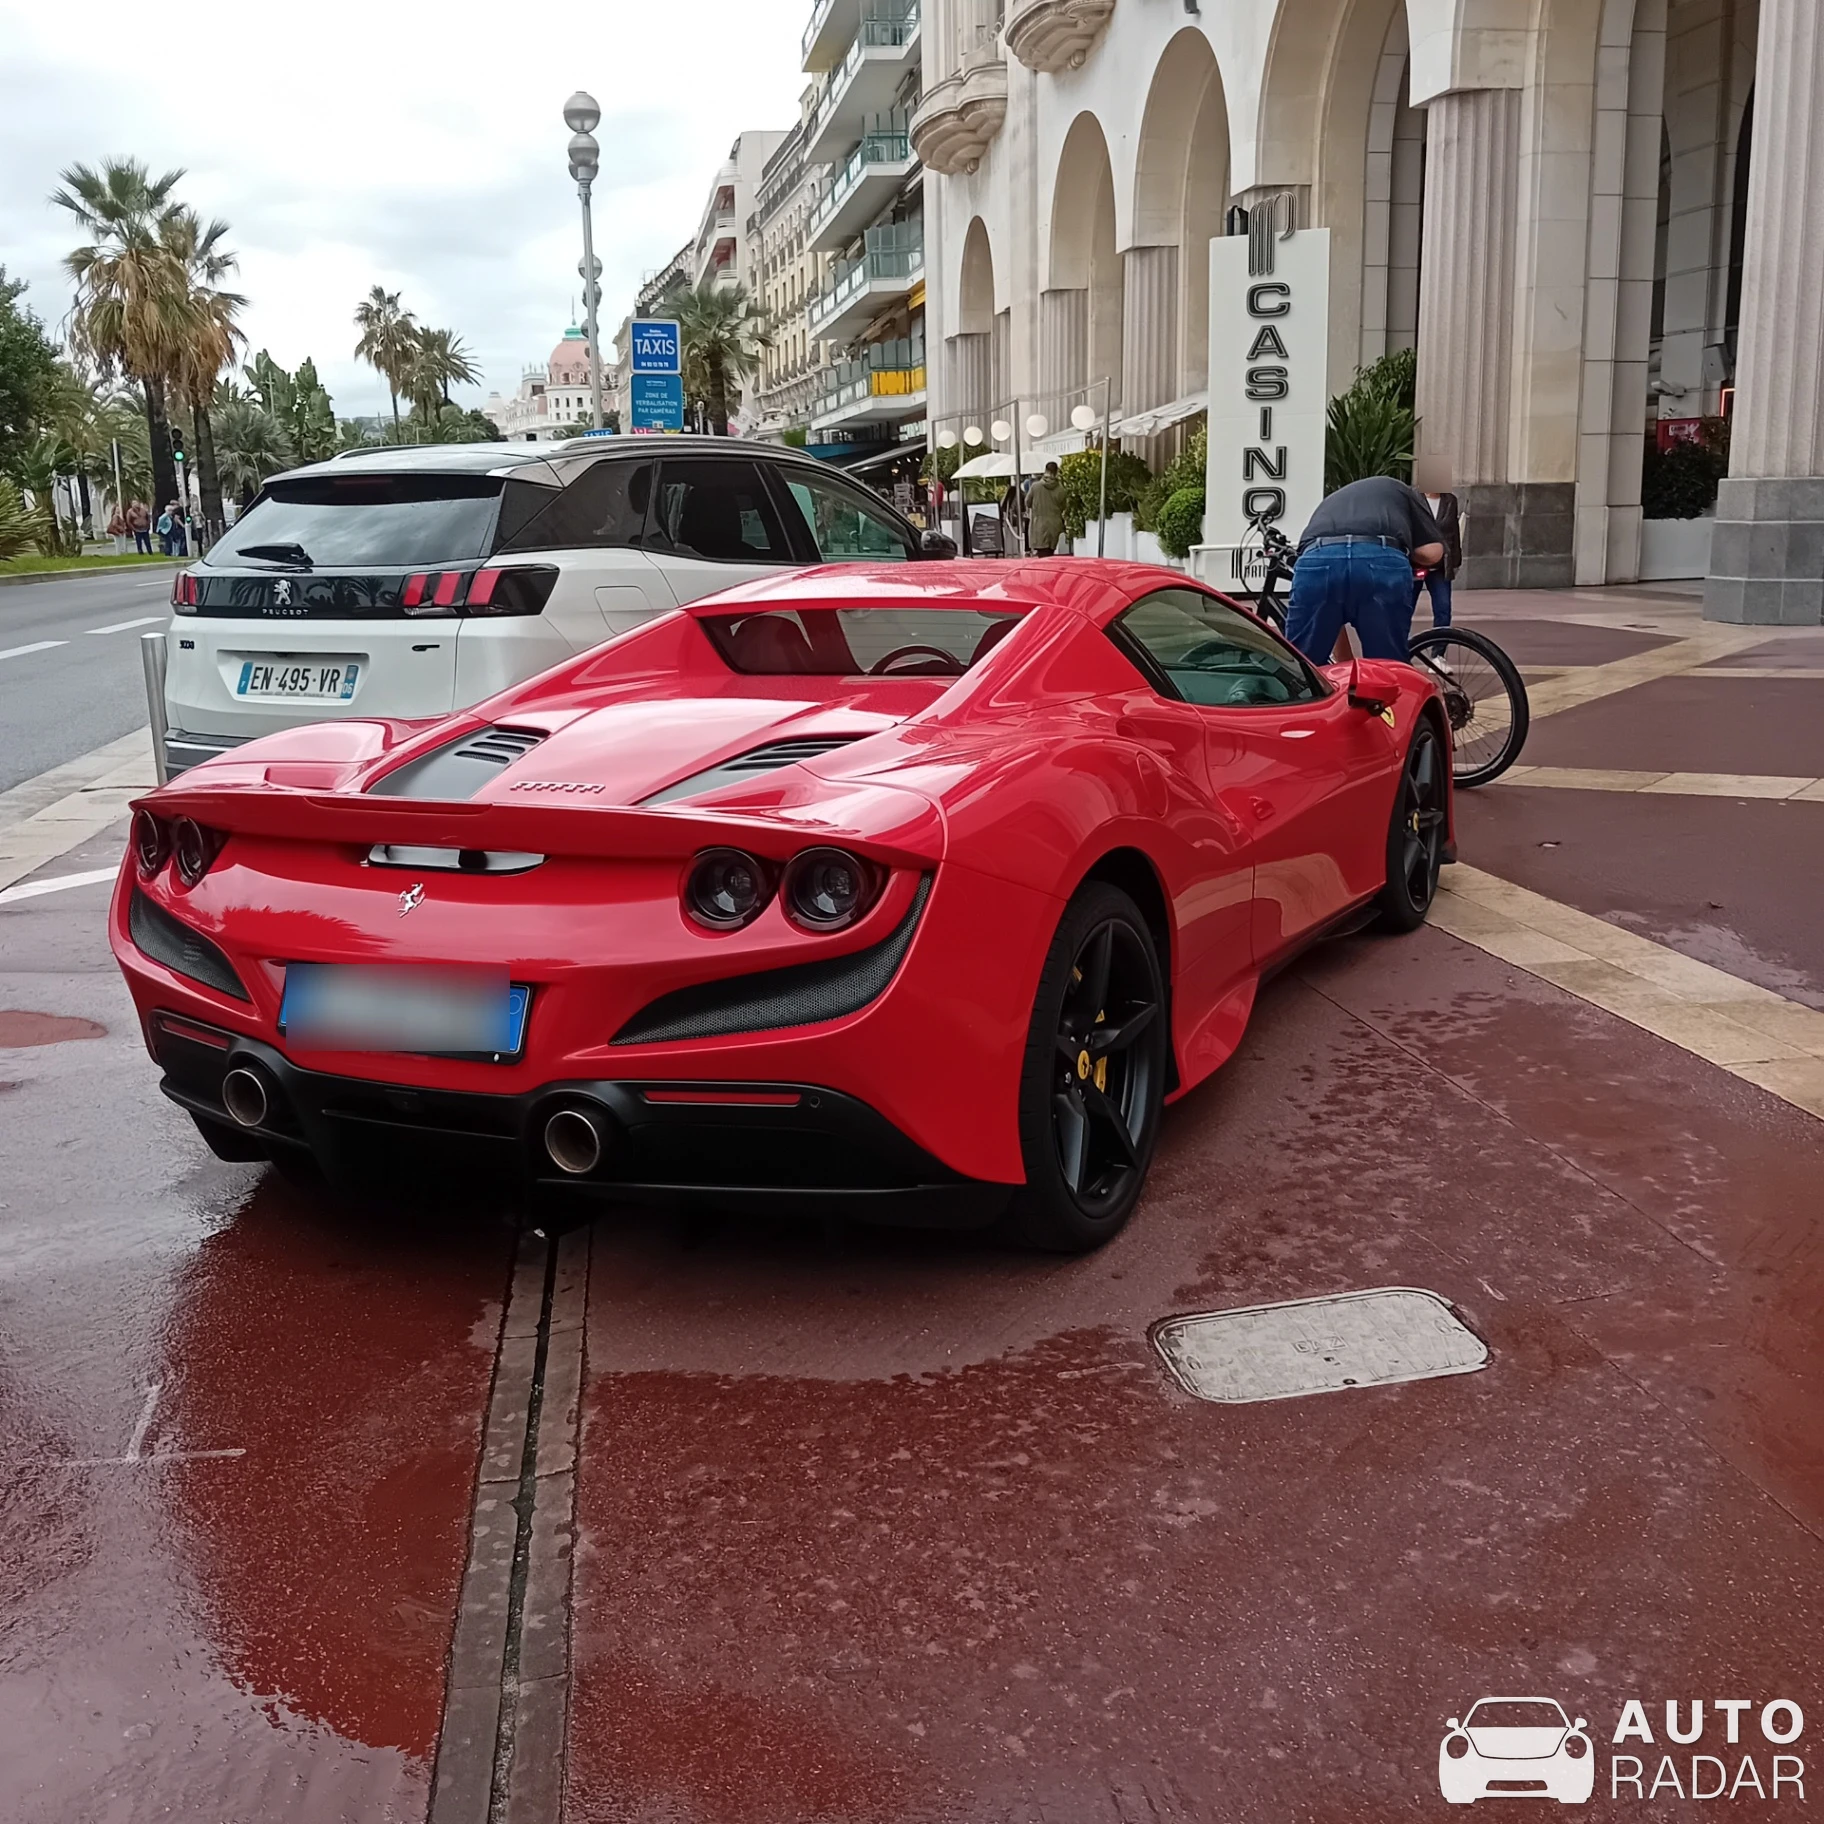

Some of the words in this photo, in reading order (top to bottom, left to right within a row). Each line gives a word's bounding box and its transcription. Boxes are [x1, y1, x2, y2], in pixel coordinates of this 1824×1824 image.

[634, 338, 676, 355] TAXIS
[1242, 281, 1291, 521] CASINO
[262, 608, 309, 616] PEUGEOT
[341, 682, 353, 694] 06
